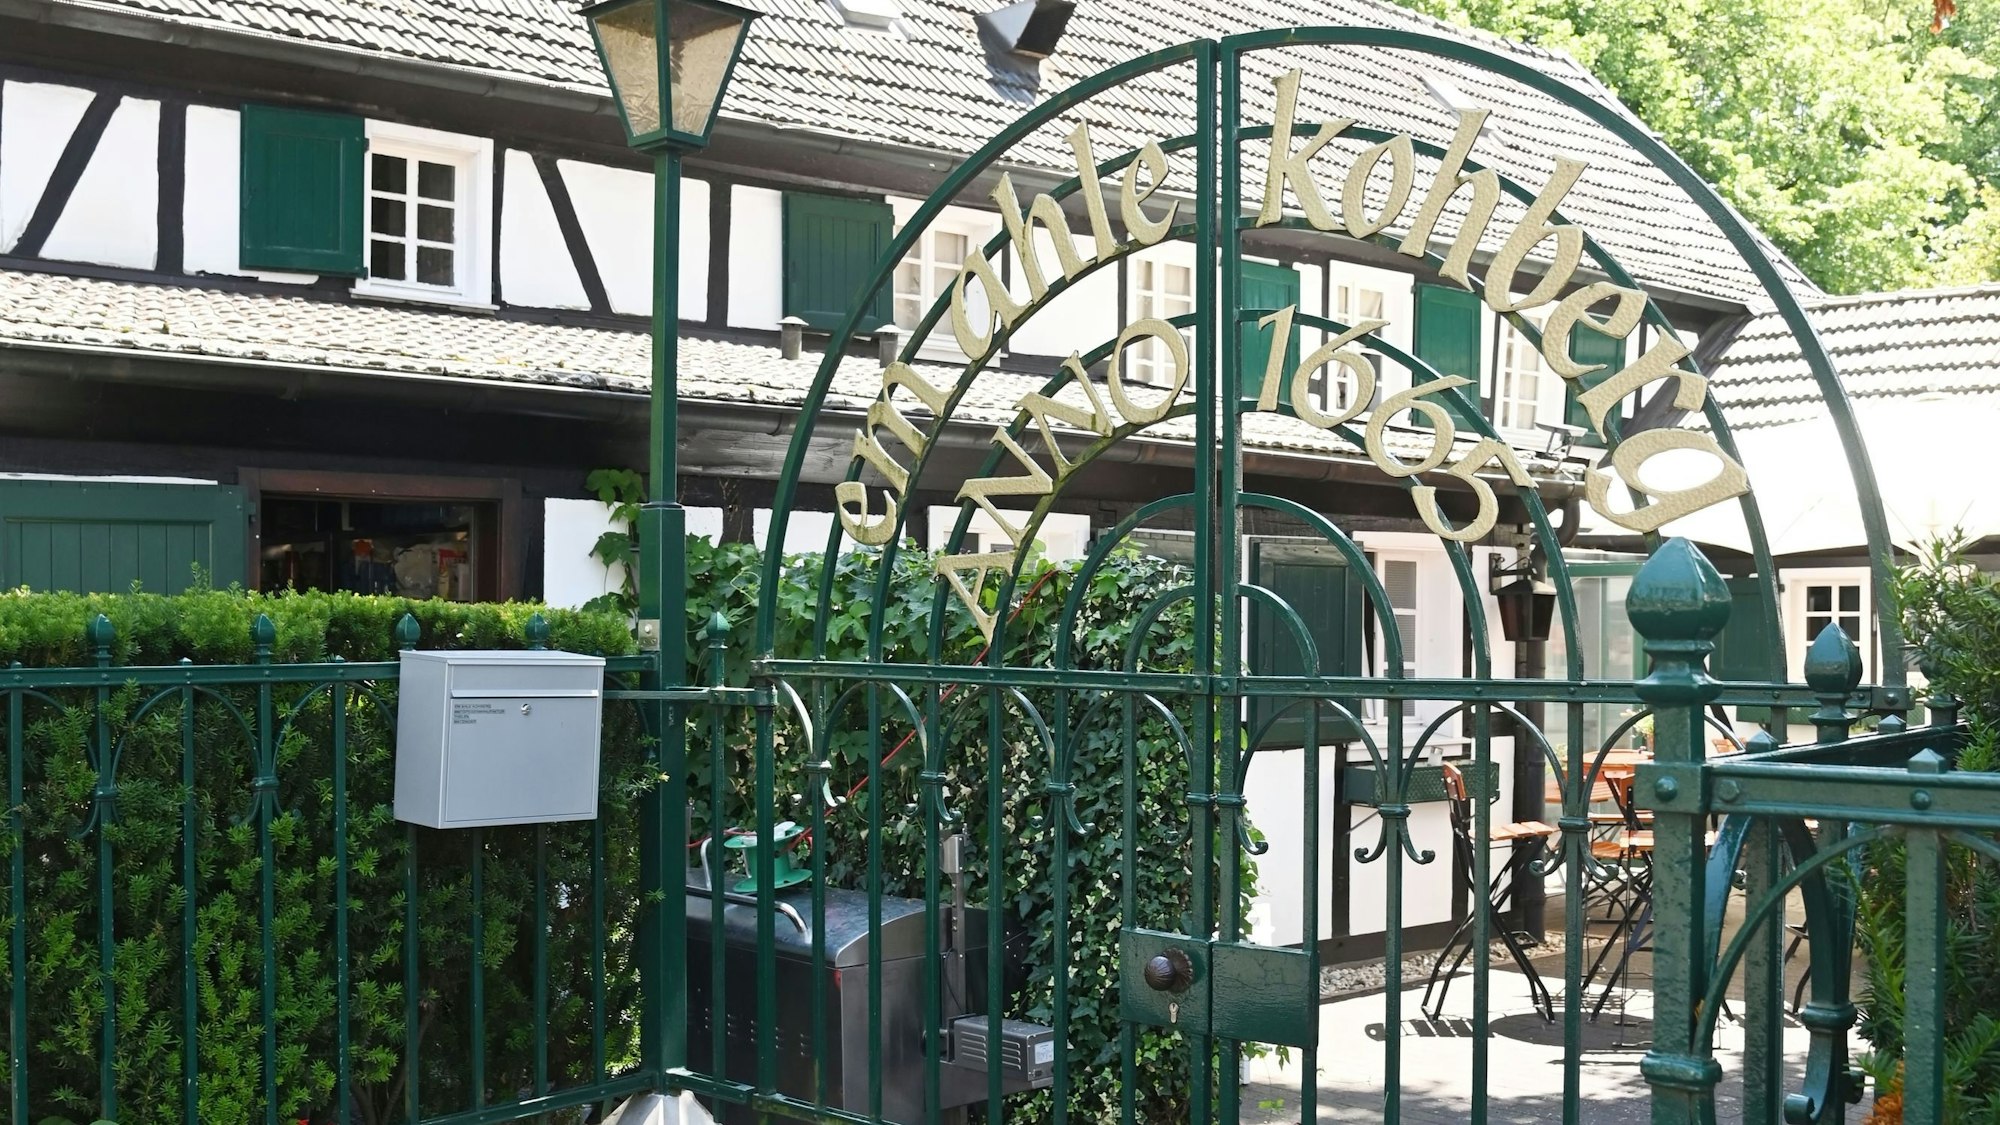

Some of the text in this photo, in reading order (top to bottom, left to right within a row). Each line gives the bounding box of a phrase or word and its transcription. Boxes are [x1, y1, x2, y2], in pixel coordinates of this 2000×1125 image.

[835, 68, 1749, 545] em ahle kohberg
[935, 304, 1538, 645] ANNO 1665
